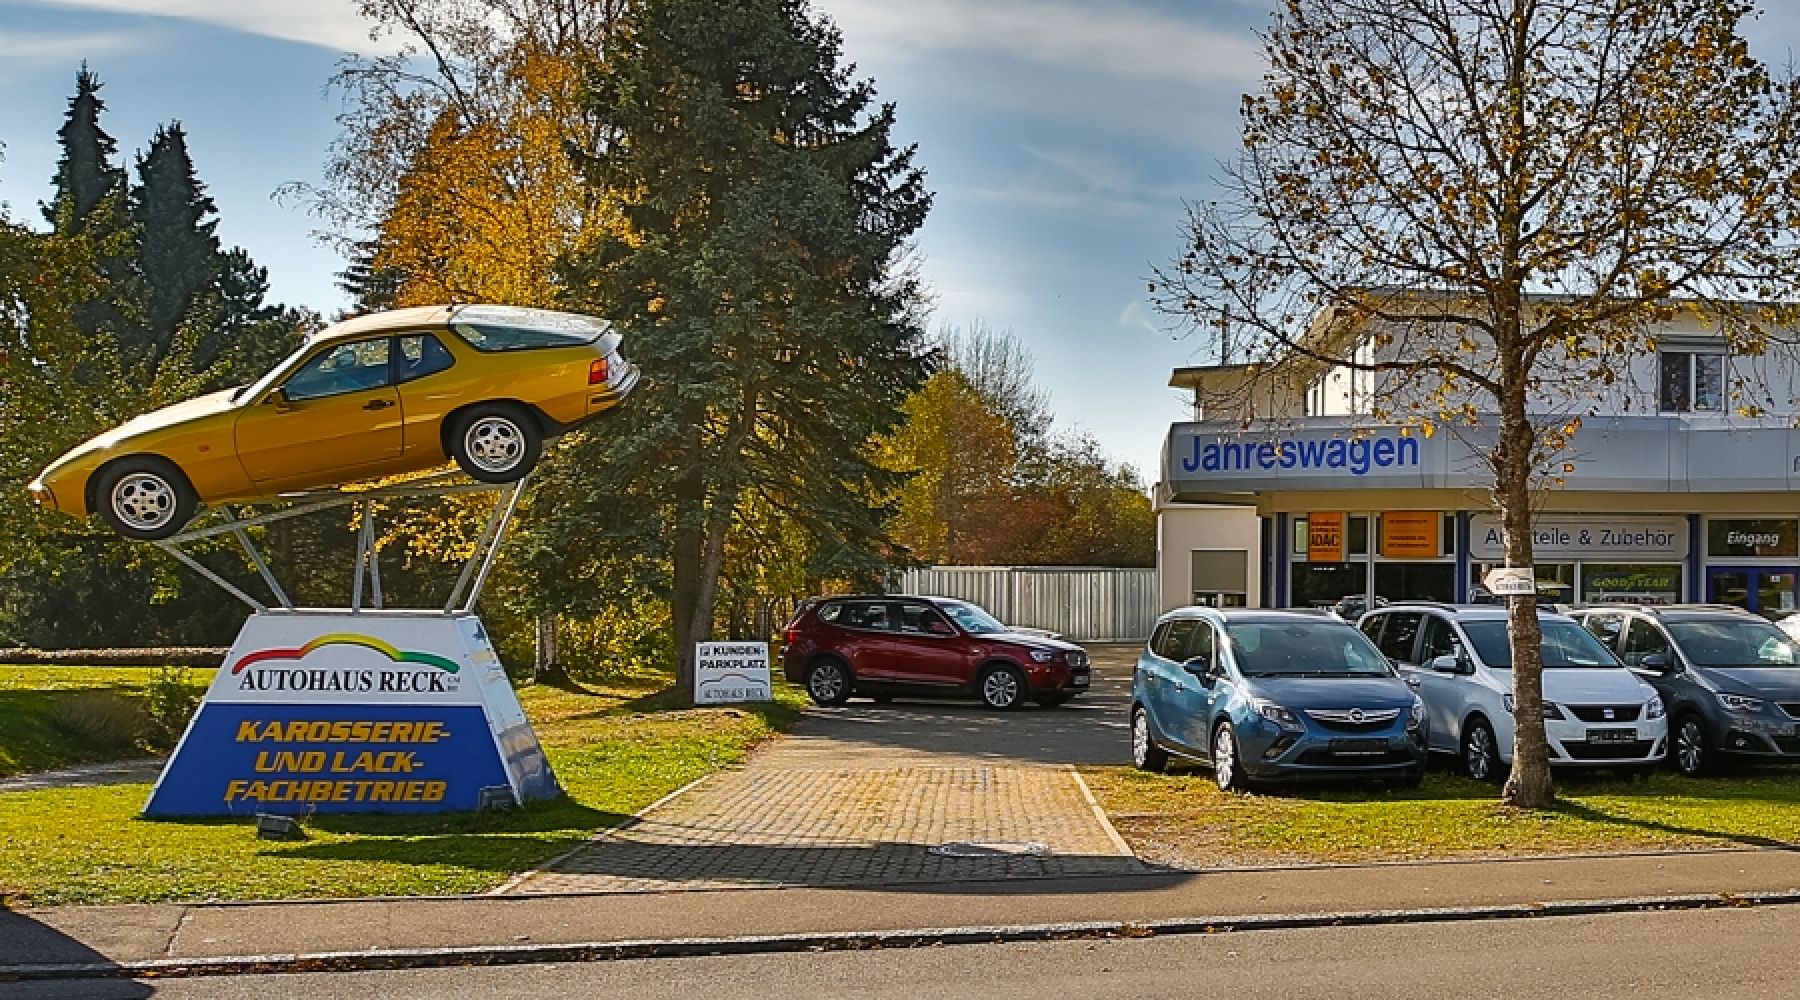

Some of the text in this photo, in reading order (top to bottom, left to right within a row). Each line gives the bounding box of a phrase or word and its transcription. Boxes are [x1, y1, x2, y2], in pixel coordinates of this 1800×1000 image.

[1182, 435, 1420, 475] Jahreswagen
[1578, 528, 1592, 546] &
[1599, 528, 1675, 546] Zubehör
[1727, 531, 1779, 547] Eingang
[699, 659, 767, 669] PARKPLATZ
[239, 669, 372, 692] AUTOHAUS
[378, 669, 445, 692] RECK
[235, 721, 451, 742] KAROSSERIE-
[255, 751, 424, 772] UND LACK-
[224, 779, 448, 802] FACHBETRIEB
